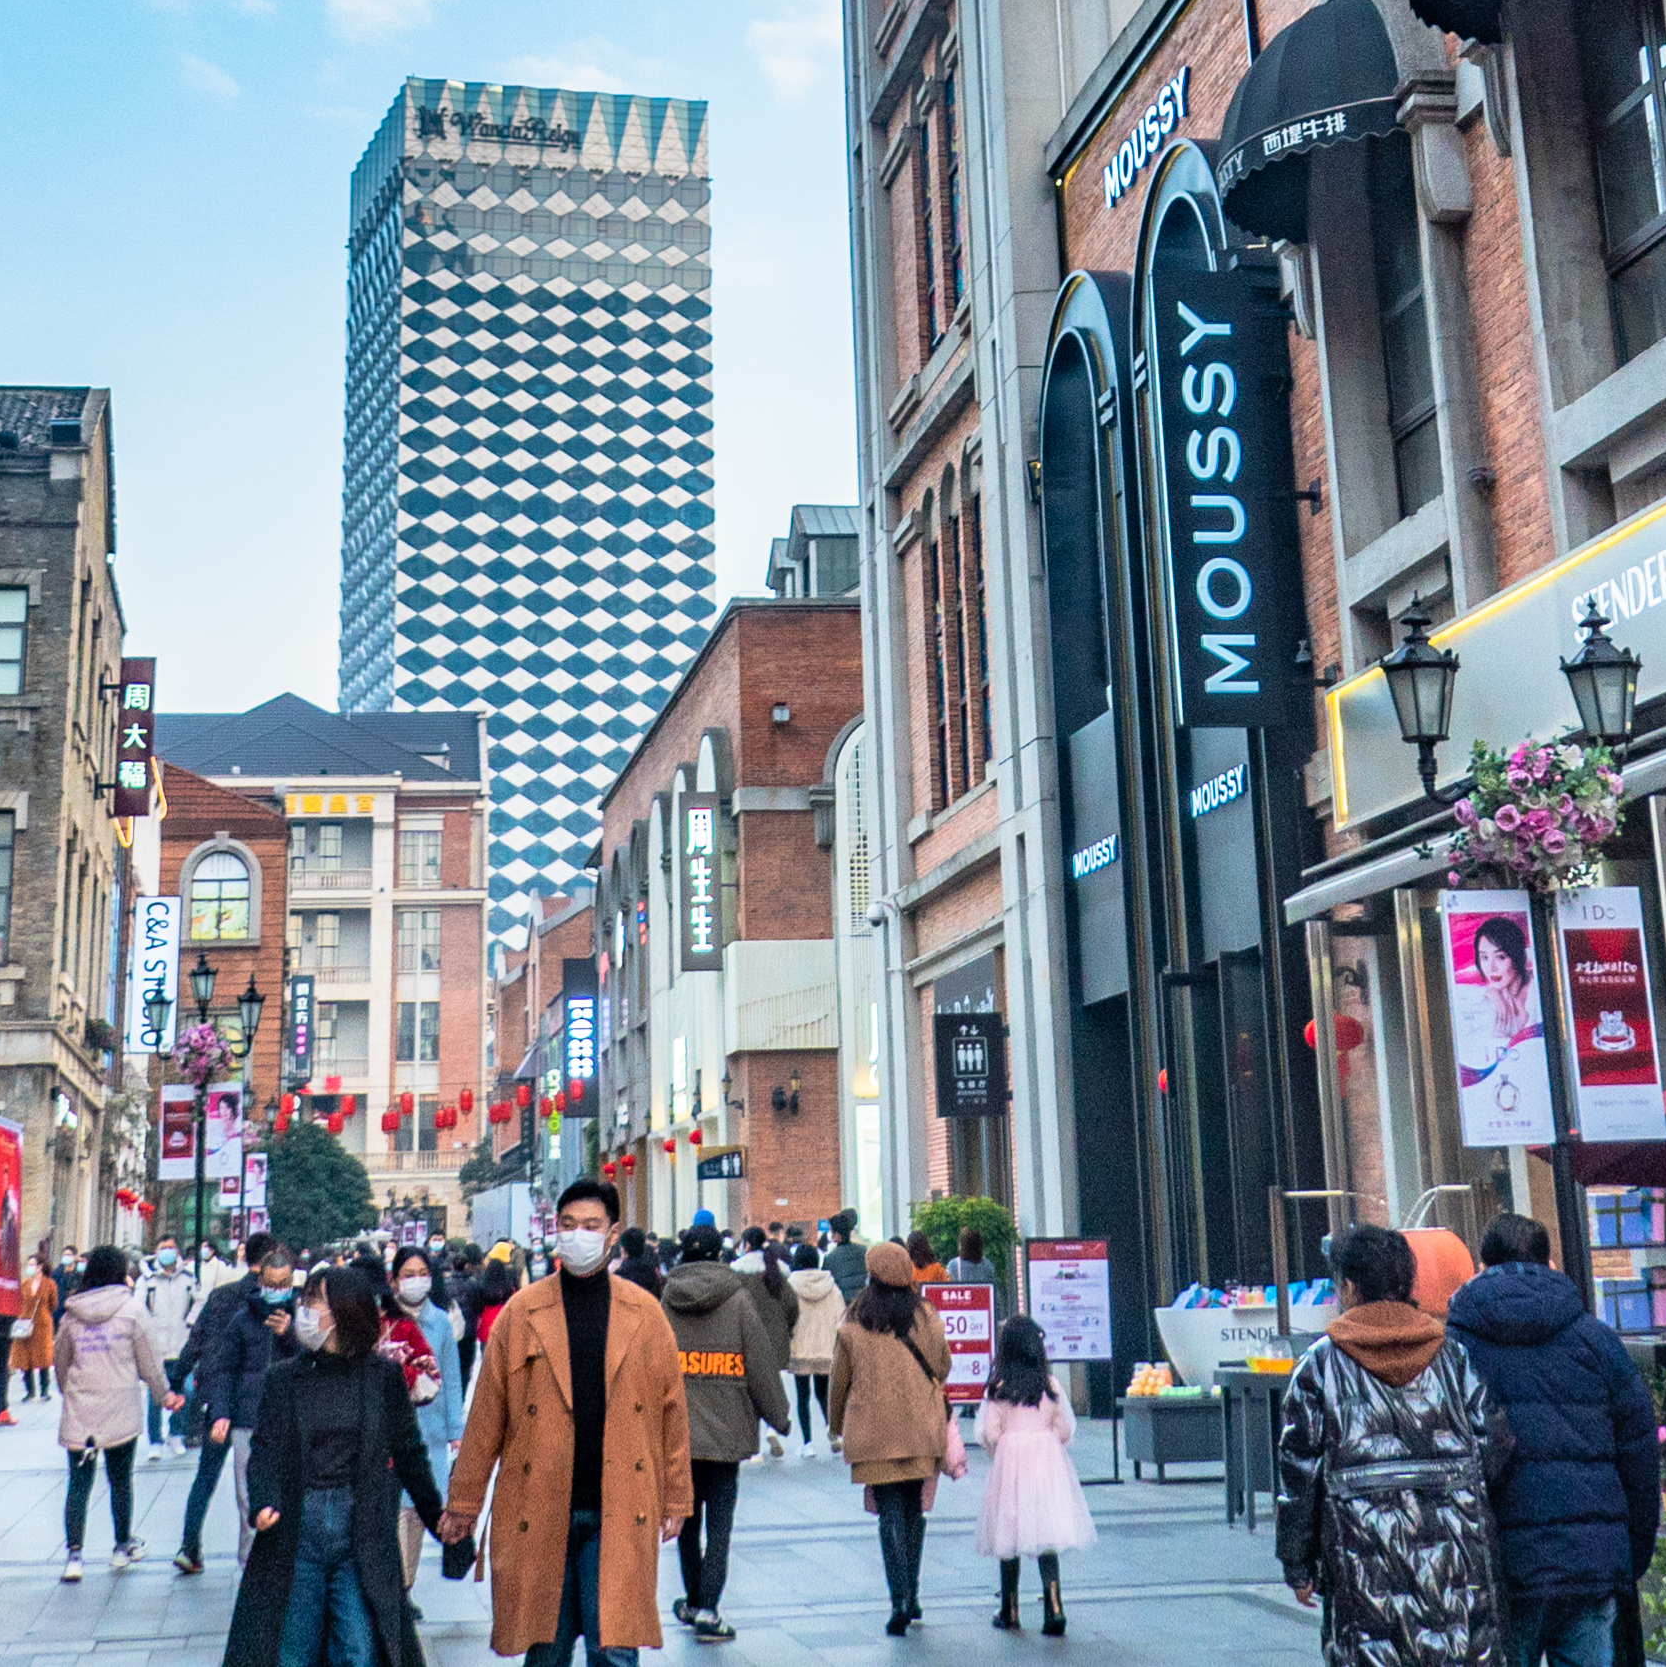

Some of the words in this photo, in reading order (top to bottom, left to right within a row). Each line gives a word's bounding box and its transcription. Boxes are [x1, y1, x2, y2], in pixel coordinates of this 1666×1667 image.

[1102, 65, 1192, 209] MOUSSY
[1262, 111, 1347, 159] 西堤牛排
[1177, 300, 1261, 694] MOUSSY
[118, 682, 150, 790] 周大福
[1190, 763, 1246, 819] MOUSSY
[685, 808, 714, 953] 周生生
[1072, 833, 1117, 879] MOUSSY
[145, 901, 170, 951] C&A
[941, 1289, 973, 1302] SALE
[945, 1315, 968, 1335] 50
[971, 1360, 982, 1375] 8
